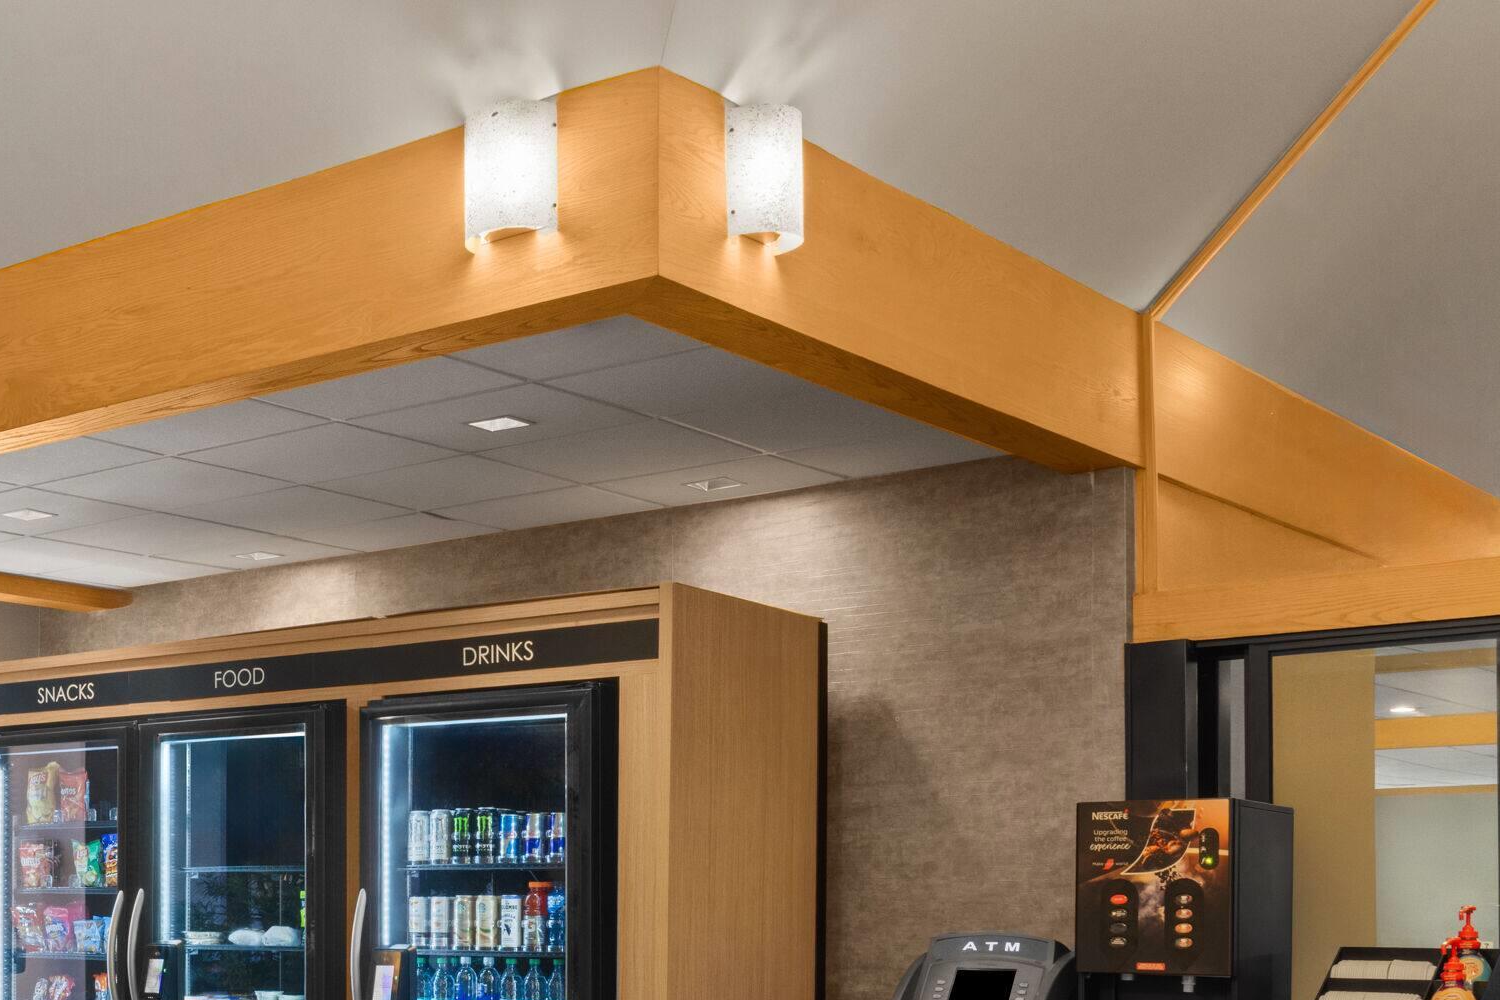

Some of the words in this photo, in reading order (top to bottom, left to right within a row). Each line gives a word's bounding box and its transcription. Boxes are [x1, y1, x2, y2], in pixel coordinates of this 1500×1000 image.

[462, 640, 534, 666] DRINKS
[214, 667, 265, 689] FOOD
[37, 682, 95, 704] SNACKS
[1089, 843, 1131, 852] experience
[962, 941, 1020, 952] ATM
